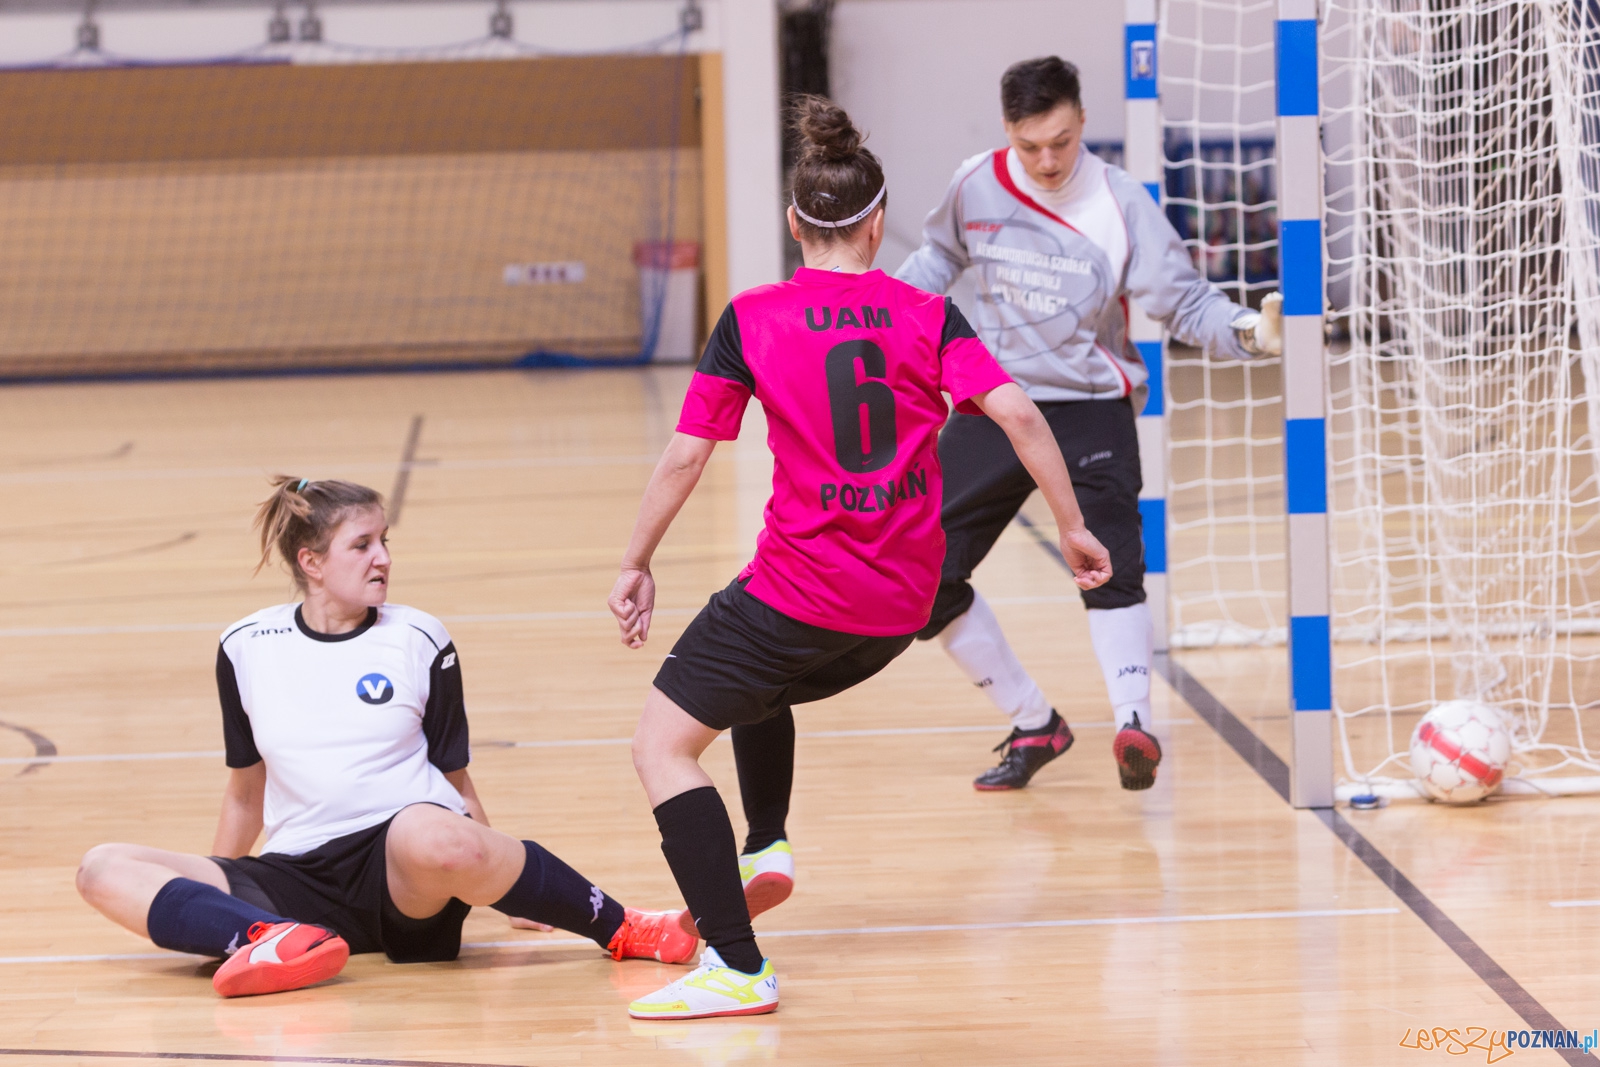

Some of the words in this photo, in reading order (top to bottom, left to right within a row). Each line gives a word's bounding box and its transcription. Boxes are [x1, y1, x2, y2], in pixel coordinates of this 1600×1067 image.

[804, 305, 893, 332] UAM
[825, 339, 898, 474] 6
[820, 462, 928, 513] POZNAŃ
